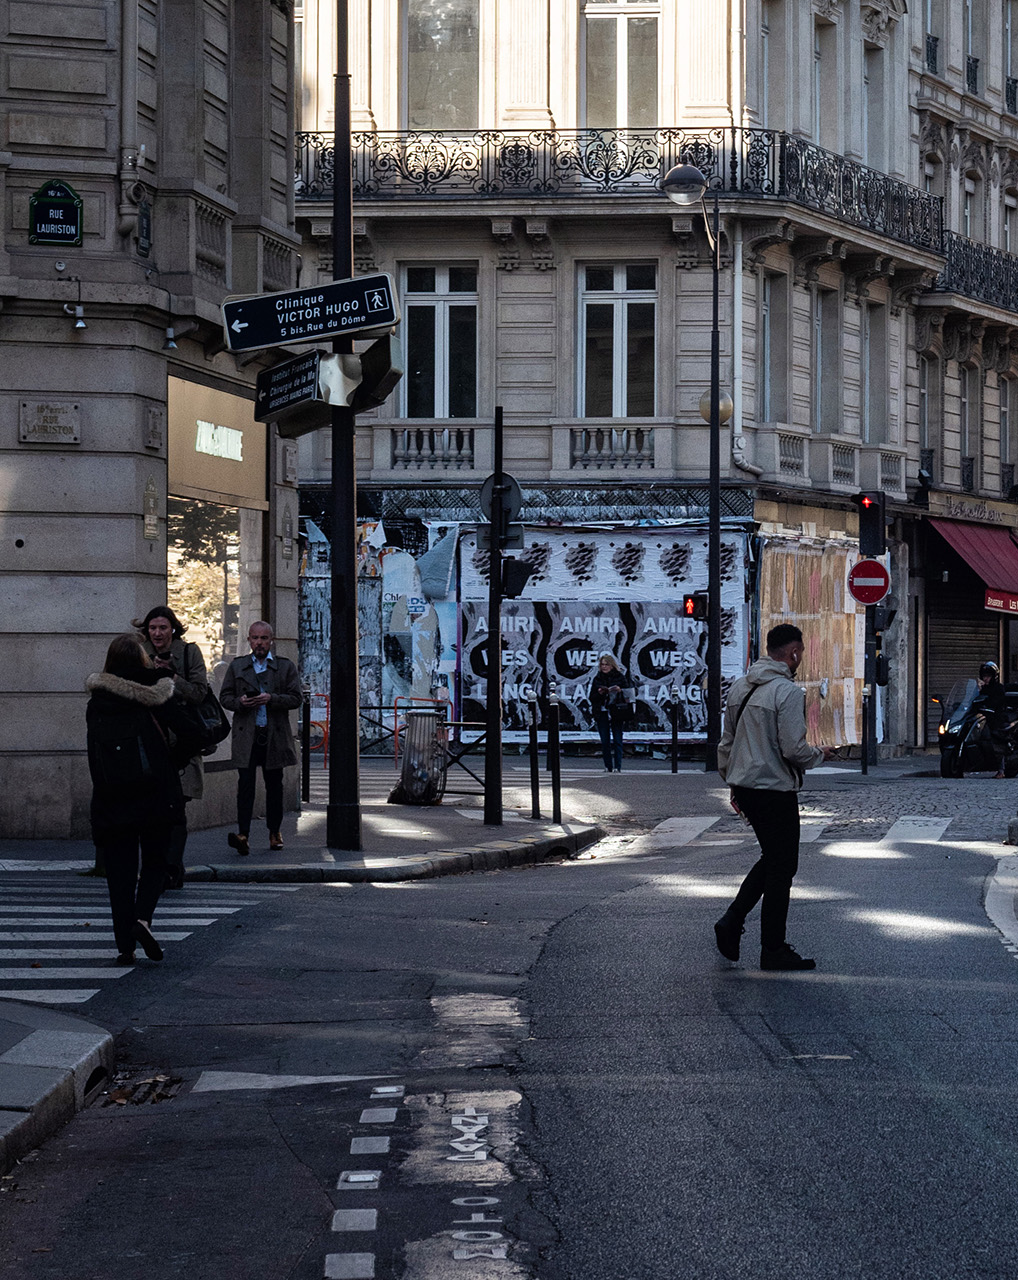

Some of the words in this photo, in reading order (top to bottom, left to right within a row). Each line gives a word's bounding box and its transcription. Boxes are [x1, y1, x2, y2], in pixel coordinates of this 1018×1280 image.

[49, 209, 64, 219] RUE
[37, 223, 76, 235] LAURISTON
[275, 294, 325, 311] Clinique
[277, 307, 321, 324] VICTOR
[325, 300, 359, 316] HUGO
[280, 327, 287, 337] 5
[327, 320, 338, 328] du
[341, 314, 366, 325] Dôme
[293, 377, 301, 387] de
[300, 374, 307, 384] la
[42, 415, 59, 424] RUE
[26, 424, 74, 435] LAURISTON
[560, 616, 620, 633] AMIRI
[643, 616, 703, 634] AMIRI
[649, 650, 697, 667] WES
[477, 683, 533, 700] LNG
[560, 683, 592, 700] LA
[644, 684, 702, 701] LANG
